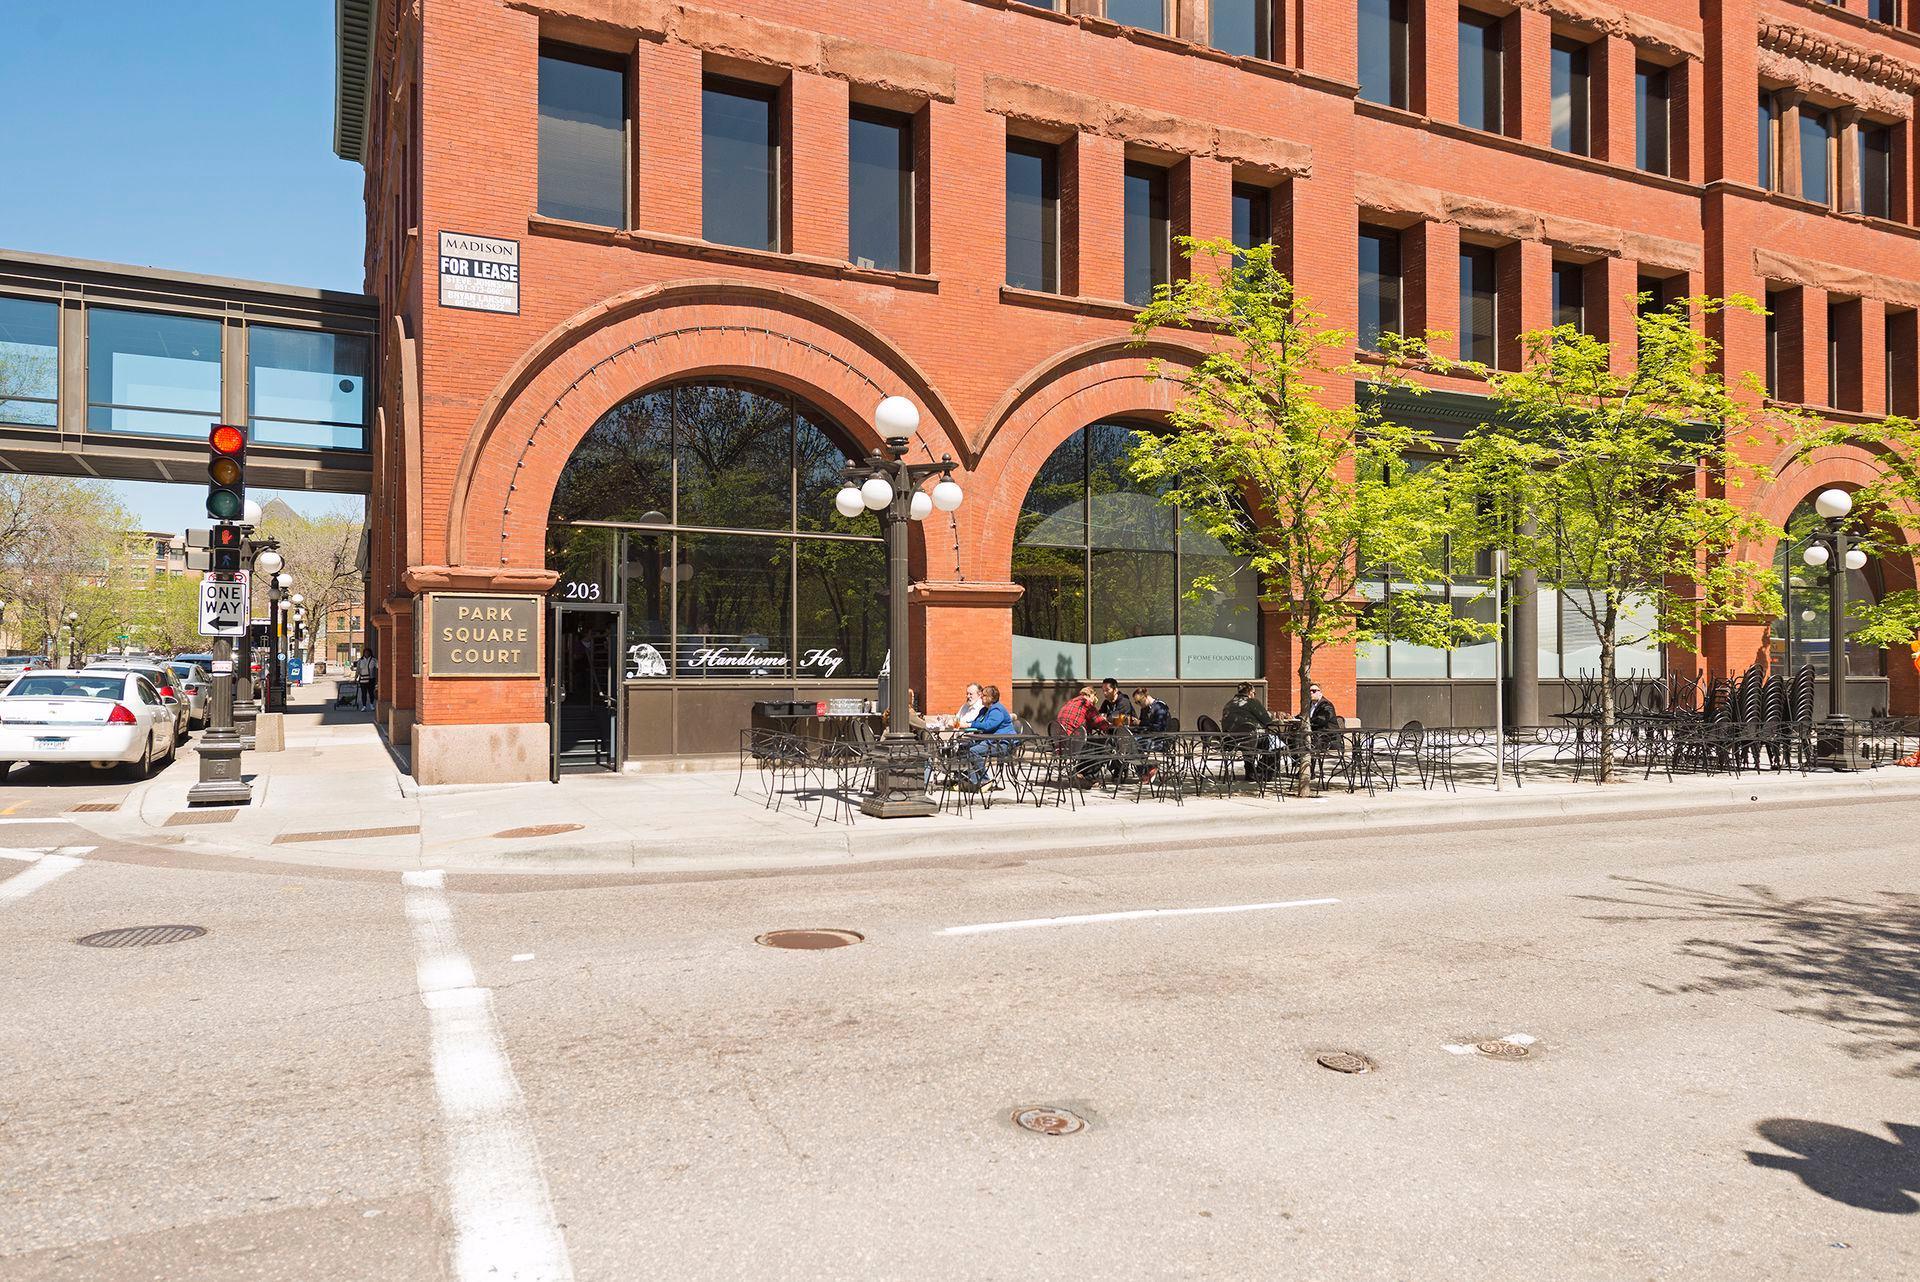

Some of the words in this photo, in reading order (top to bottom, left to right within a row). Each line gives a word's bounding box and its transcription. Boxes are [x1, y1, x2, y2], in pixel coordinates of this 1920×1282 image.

[446, 239, 513, 256] MADISON
[441, 257, 469, 276] FOR
[474, 261, 518, 282] LEASE
[207, 586, 240, 600] ONE
[566, 581, 600, 600] 203
[206, 601, 241, 614] WAY
[458, 606, 513, 621] PARK
[443, 627, 528, 644] SQUARE
[450, 648, 521, 663] COURT
[688, 647, 790, 667] Handsome
[800, 648, 844, 678] Hog
